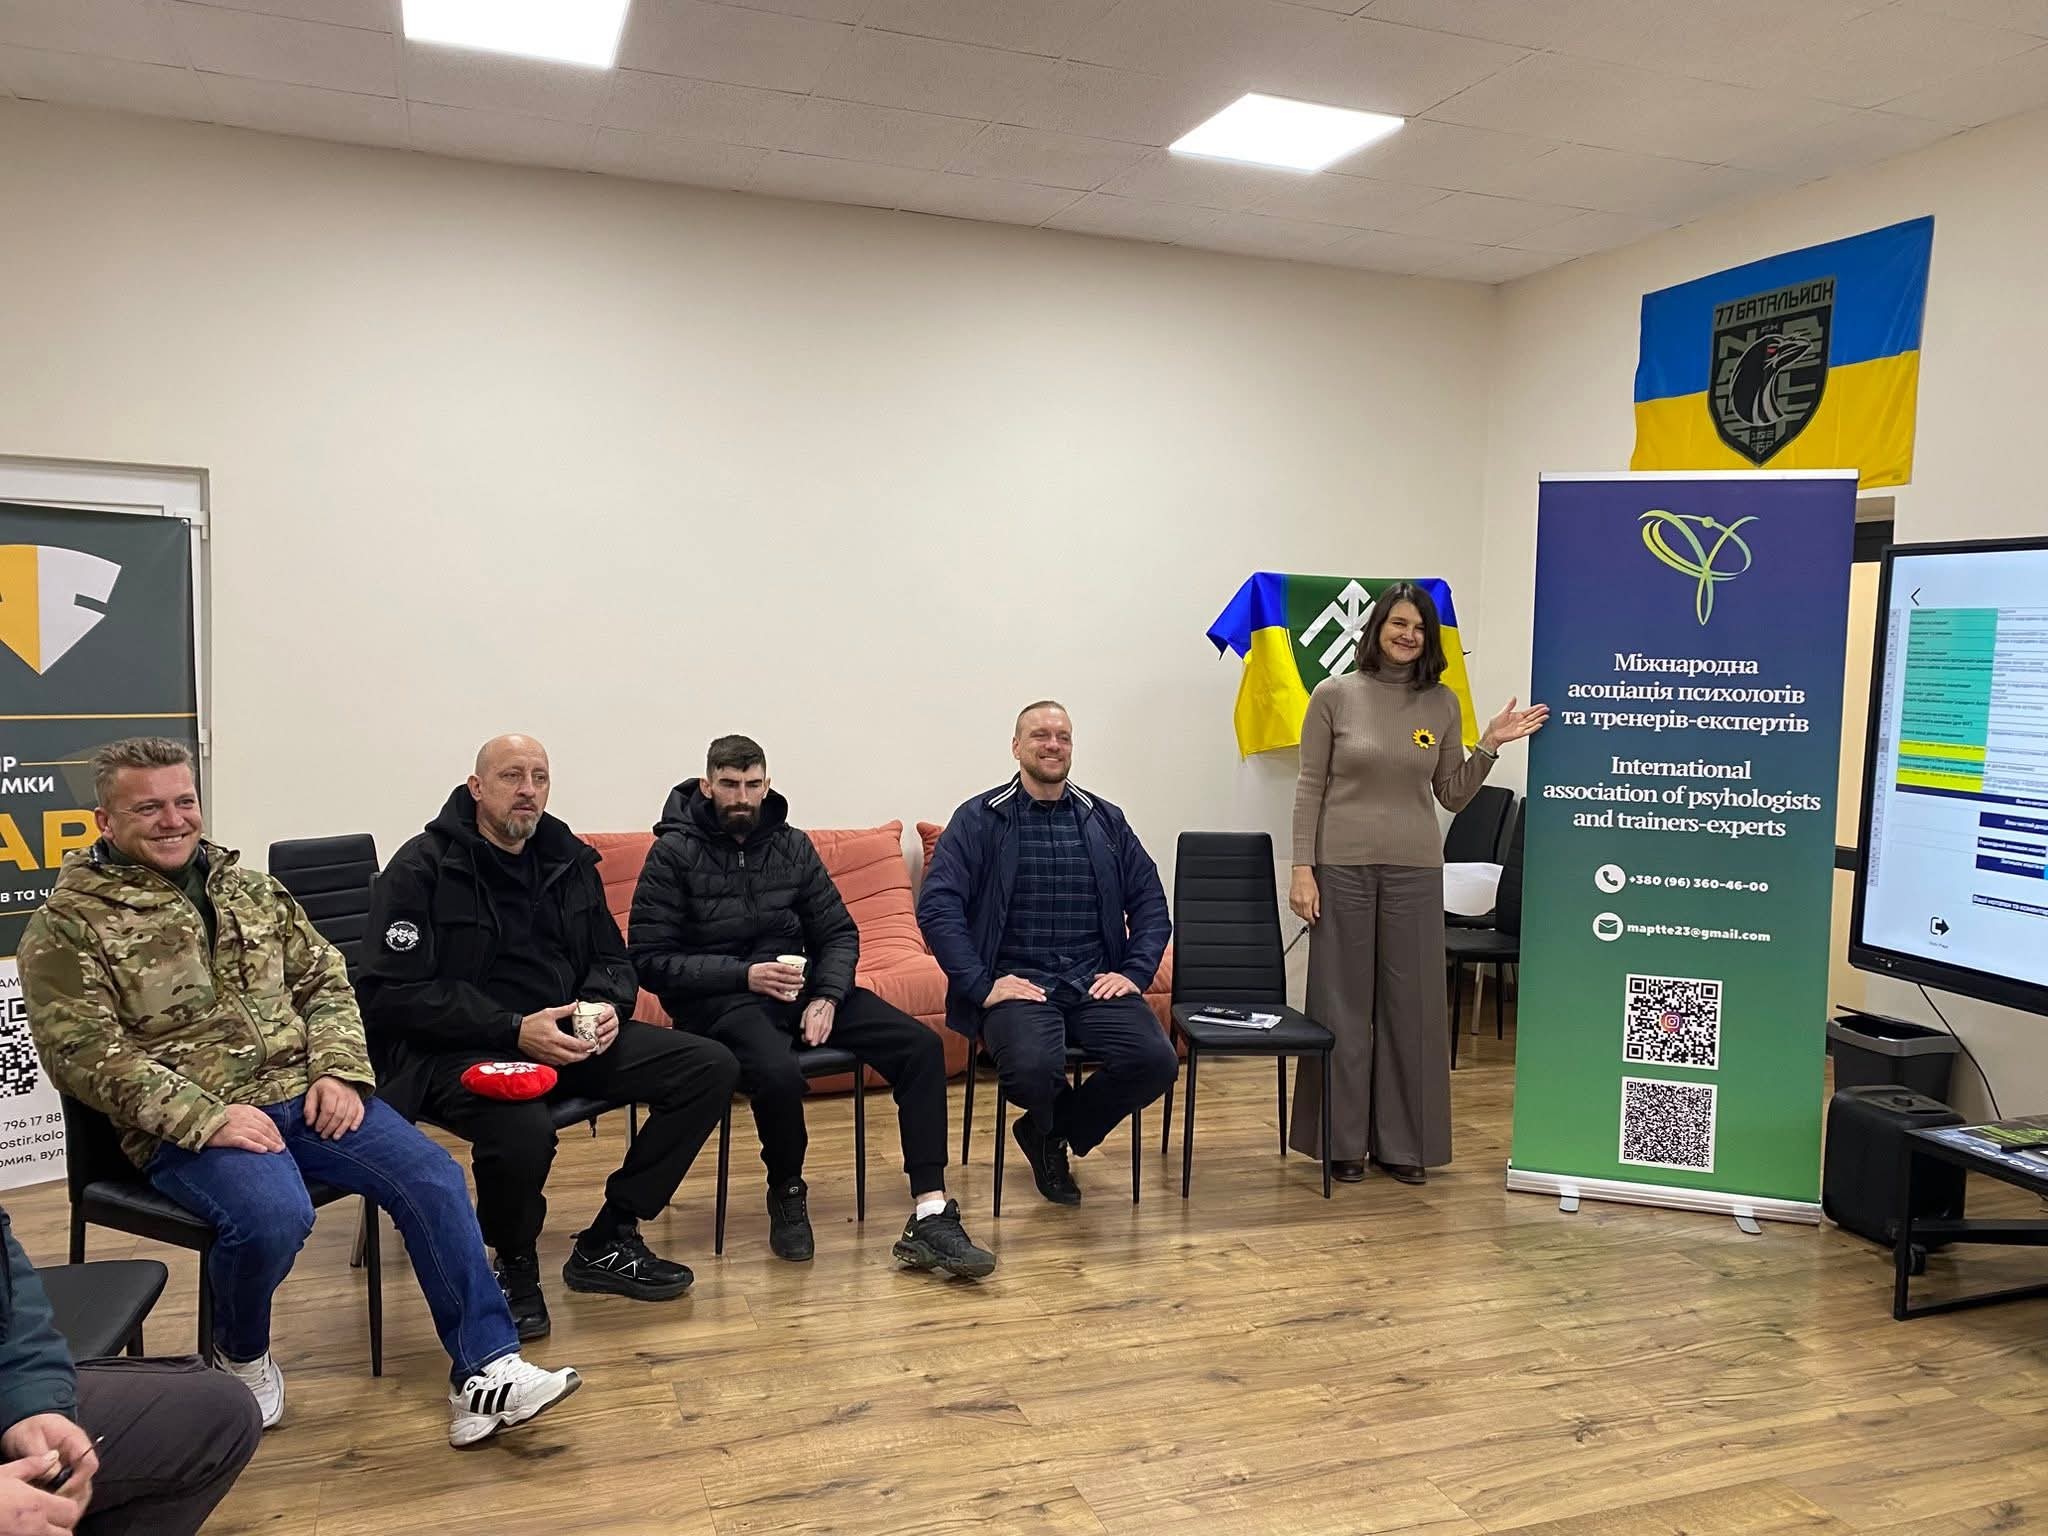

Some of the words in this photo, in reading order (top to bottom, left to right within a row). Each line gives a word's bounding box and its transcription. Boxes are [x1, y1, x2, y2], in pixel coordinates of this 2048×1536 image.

[1715, 305, 1734, 326] 77
[1736, 280, 1834, 321] БАТАЛЬЙОН
[1614, 653, 1759, 677] Міжнародна
[1567, 680, 1673, 702] асоціація
[1678, 684, 1806, 704] психологів
[1562, 711, 1586, 725] та
[1591, 709, 1809, 736] тренерів-експертів
[0, 756, 16, 773] Р
[1611, 756, 1751, 780] International
[1, 776, 54, 794] МКИ
[1543, 782, 1657, 803] association
[1662, 785, 1689, 804] of
[1688, 788, 1821, 812] psyhologists
[1573, 809, 1613, 828] and
[1617, 812, 1786, 838] trainers-experts
[13, 889, 35, 902] та
[1629, 874, 1662, 886] +380
[1664, 876, 1691, 889] (96)
[1693, 878, 1769, 893] 360-46-00
[1627, 923, 1771, 942] maptte23@gmail.com
[3, 1119, 27, 1131] 796
[30, 1115, 42, 1126] 17
[46, 1112, 62, 1124] 88
